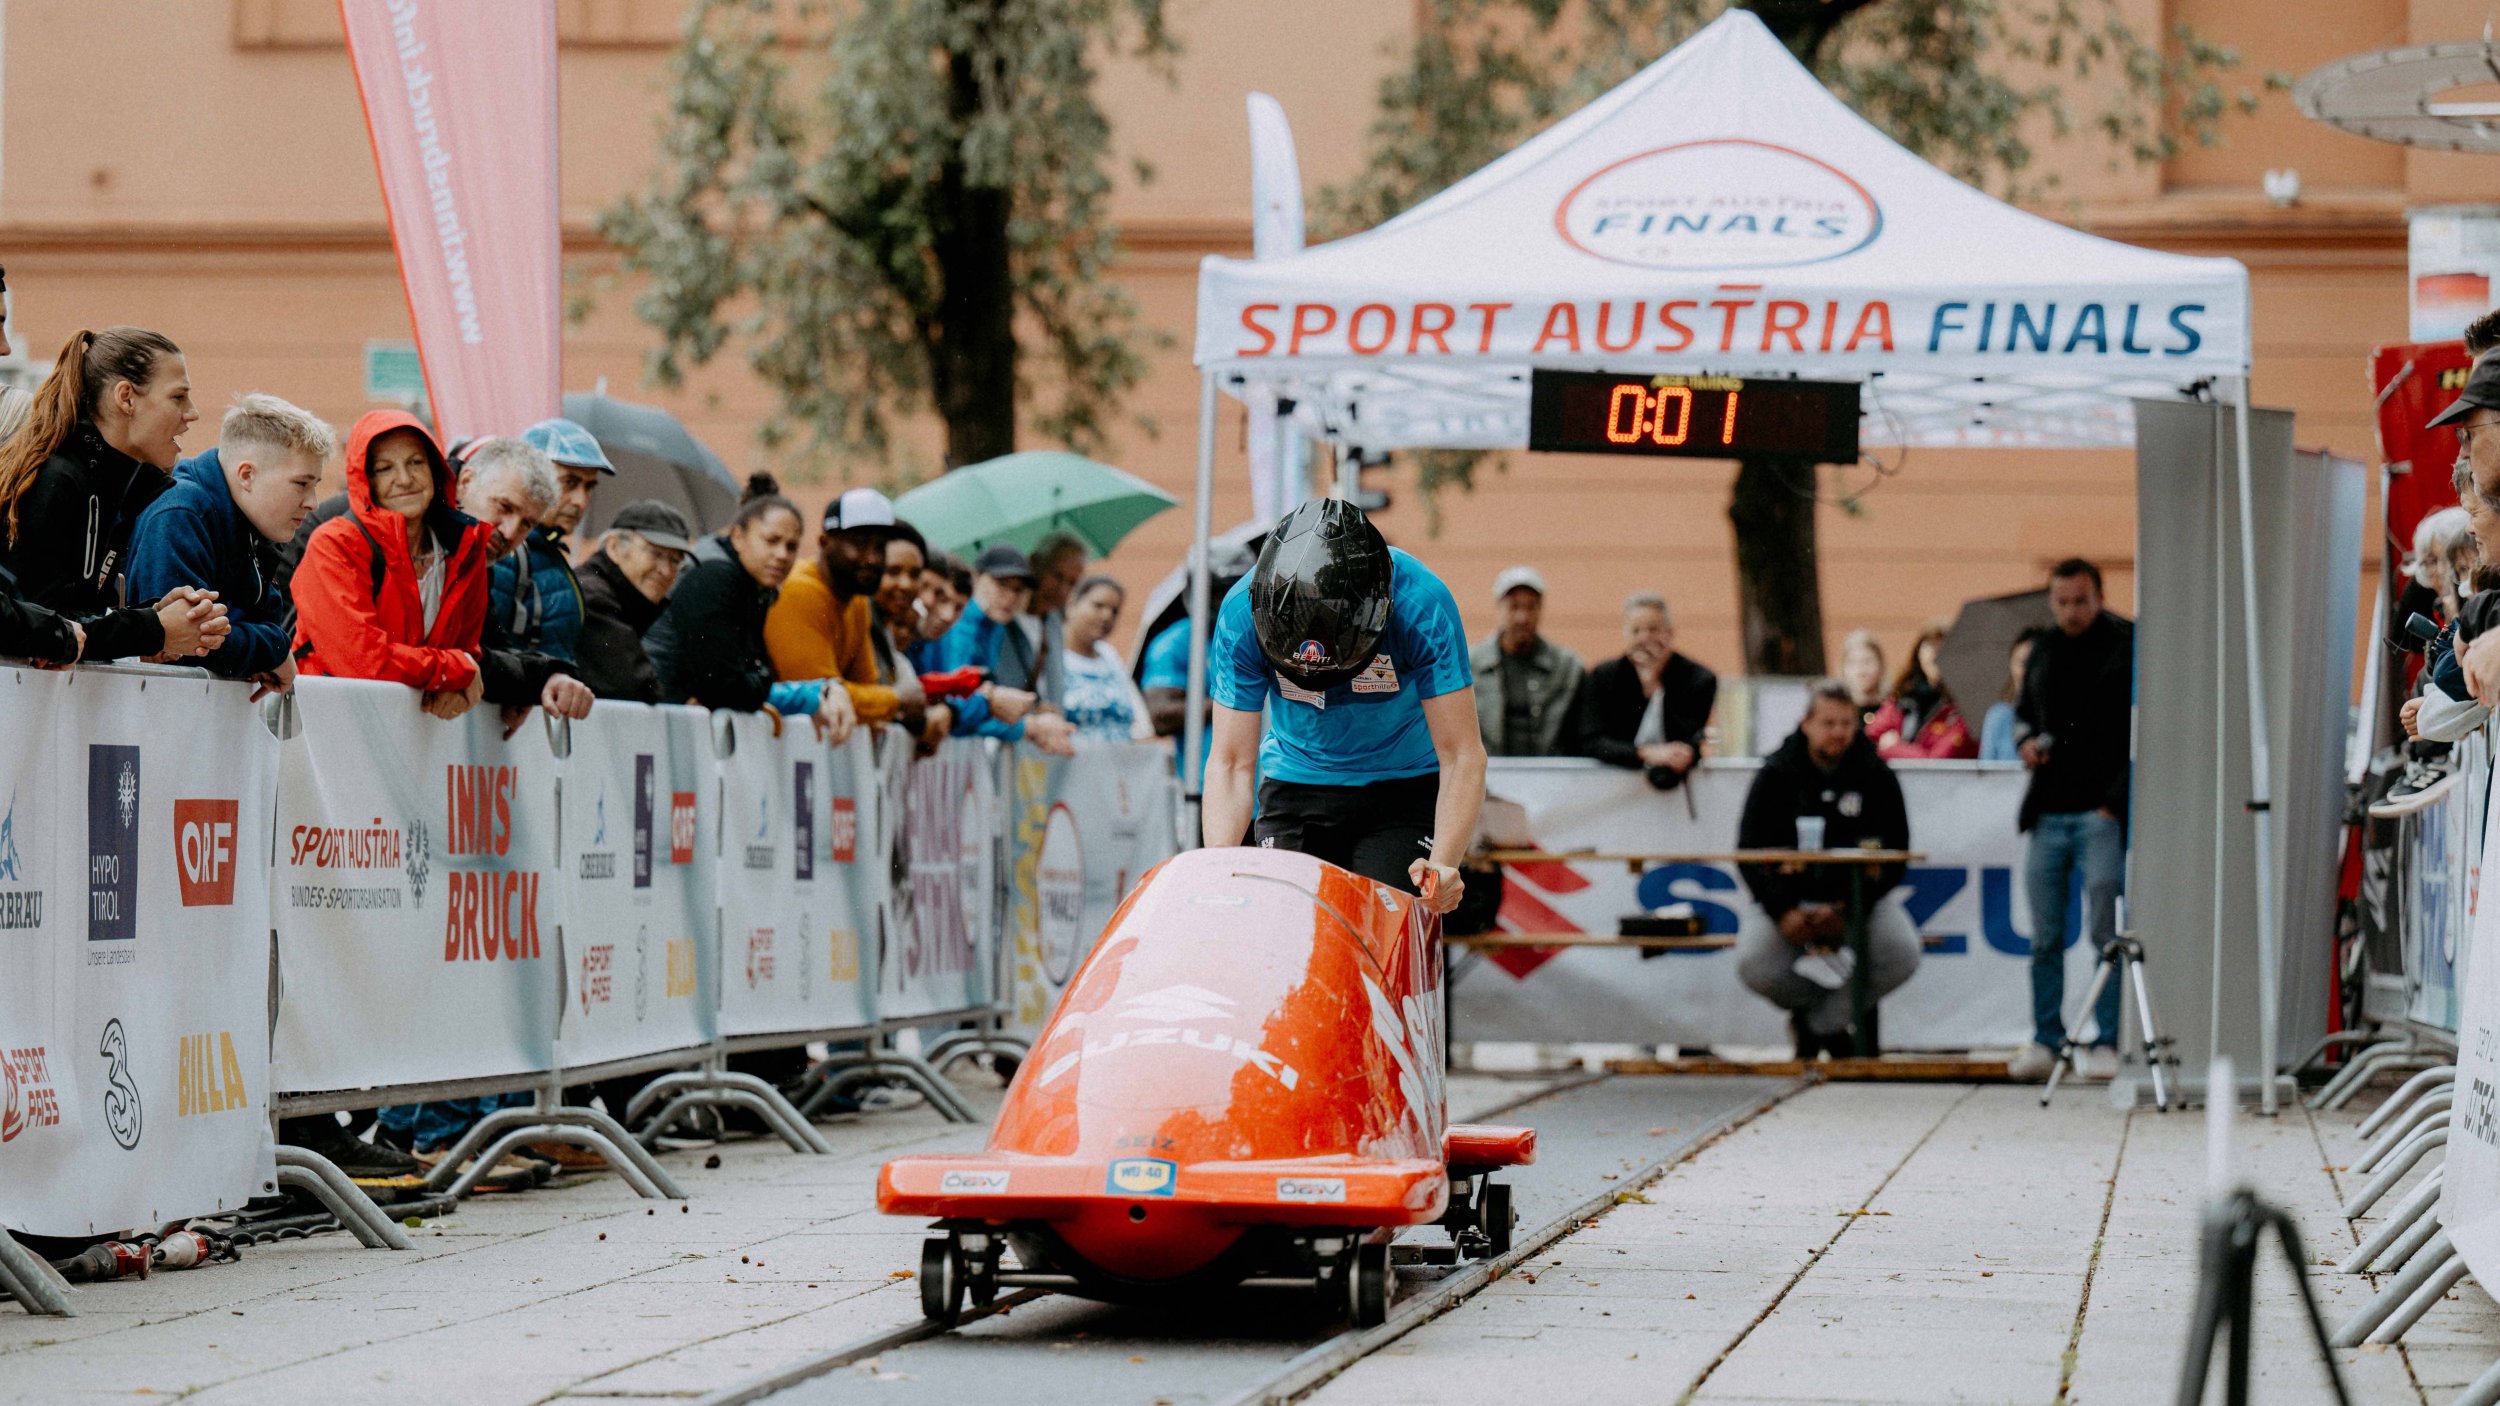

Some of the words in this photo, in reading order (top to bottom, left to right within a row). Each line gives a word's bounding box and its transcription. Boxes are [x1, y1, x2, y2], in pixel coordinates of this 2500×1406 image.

[1592, 213, 1848, 238] FINALS
[1237, 302, 1512, 358] SPORT
[1533, 283, 1895, 354] AUSTRIA
[1926, 301, 2207, 356] FINALS
[1292, 651, 1307, 662] BE
[1309, 655, 1331, 664] FIT!
[448, 764, 516, 857] INNS'
[181, 820, 232, 885] ORF
[291, 824, 345, 868] SPORT
[349, 817, 400, 868] AUSTRIA
[92, 854, 120, 884] HYPO
[92, 890, 120, 921] TIROL
[291, 885, 401, 909] BUNDES-SPORTORGANISATION
[444, 871, 541, 962] BRUCK
[11, 1046, 51, 1085] SPORT
[178, 1031, 248, 1118] BILLA
[26, 1088, 60, 1128] PASS
